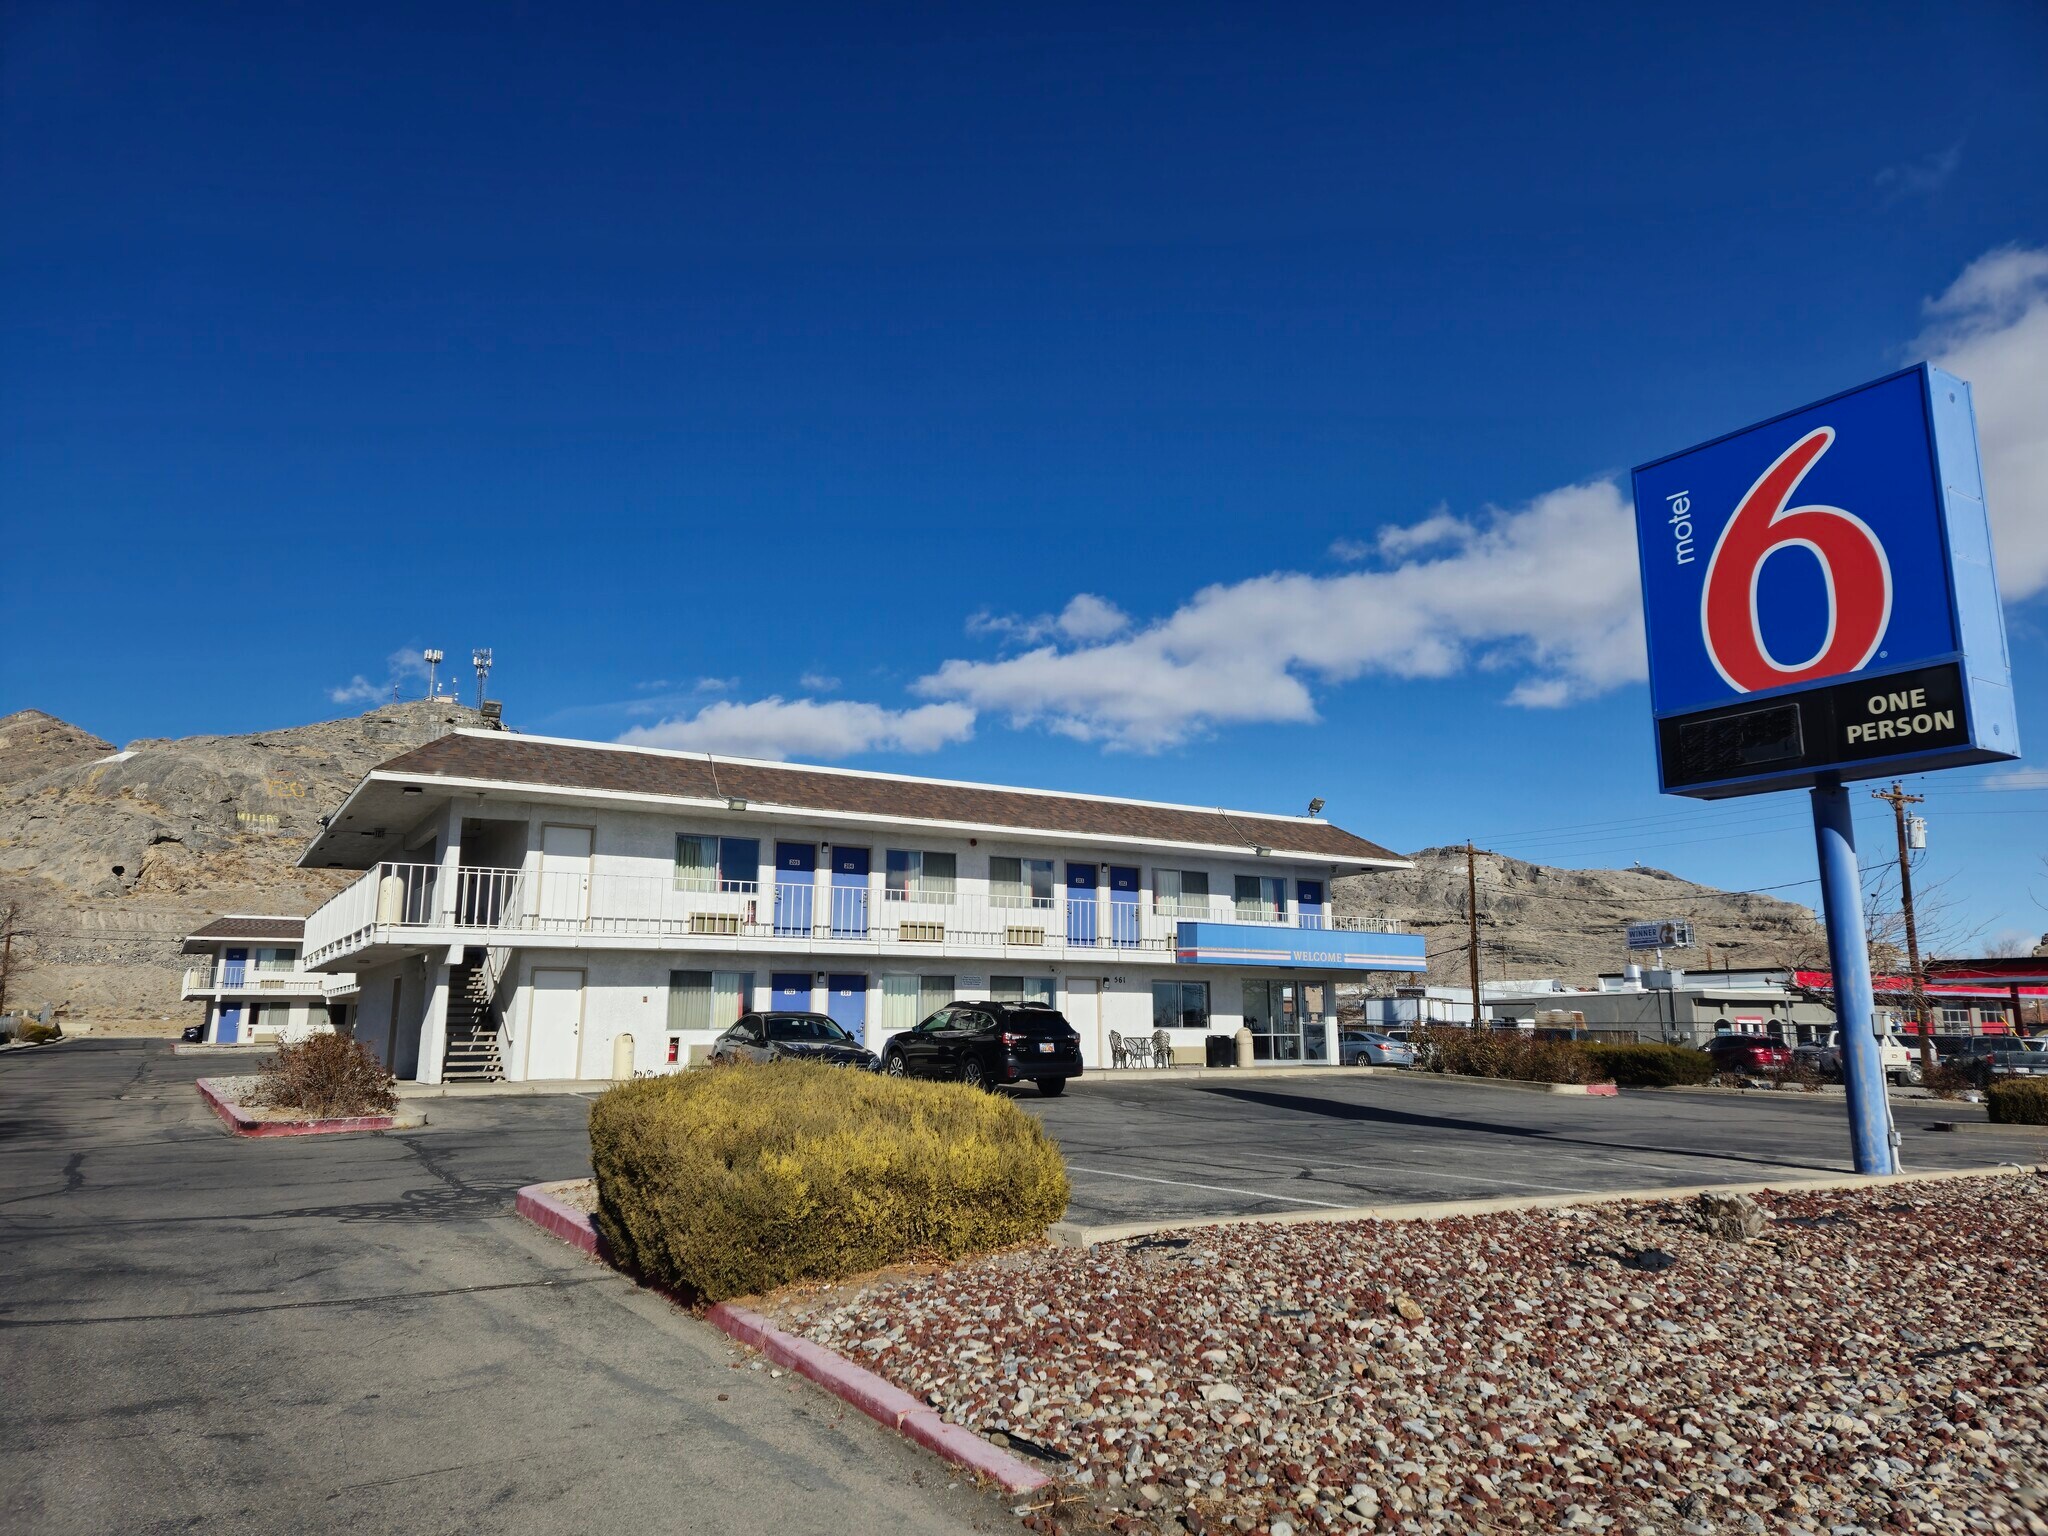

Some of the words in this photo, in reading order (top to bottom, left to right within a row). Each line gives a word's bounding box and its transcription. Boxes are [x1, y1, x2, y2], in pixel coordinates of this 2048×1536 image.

[1666, 490, 1695, 565] motel
[1701, 425, 1893, 694] 6
[1868, 688, 1926, 714] ONE
[1847, 710, 1955, 744] PERSON
[1628, 929, 1657, 938] WINNER
[1293, 951, 1342, 962] WELCOME
[1114, 976, 1126, 984] 561
